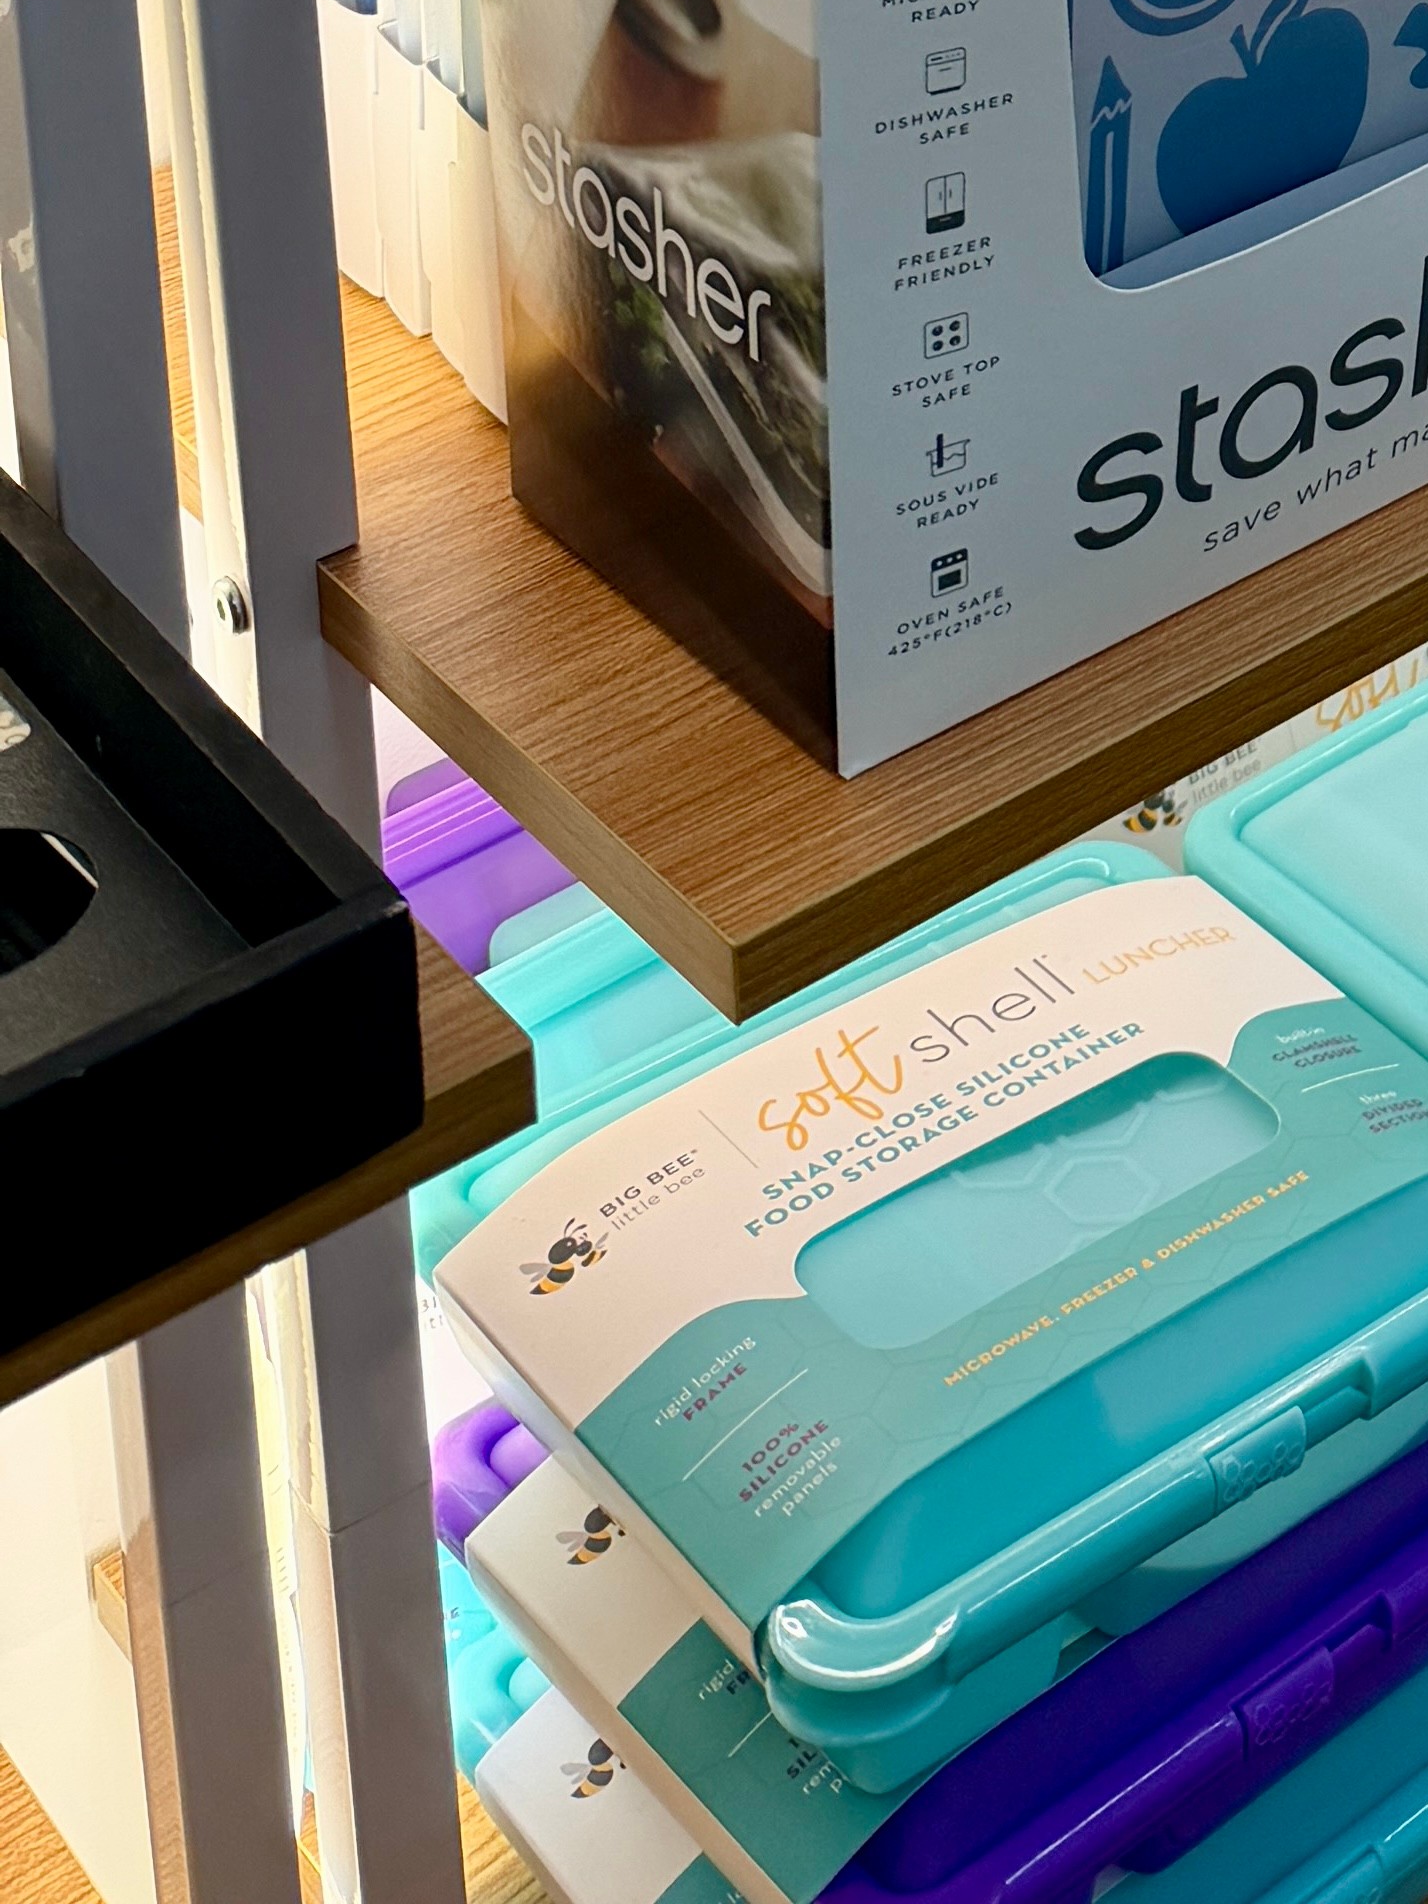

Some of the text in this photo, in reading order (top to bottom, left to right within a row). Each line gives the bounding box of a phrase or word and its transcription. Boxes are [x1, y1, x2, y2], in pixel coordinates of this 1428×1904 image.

[874, 92, 1015, 135] DISHWASHER
[521, 121, 771, 362] stasher
[891, 355, 1002, 398] STOVE TOP
[757, 923, 1240, 1153] soft shell LUNCHER
[1058, 1264, 1141, 1320] FREEZER
[1139, 1256, 1157, 1273] &
[1155, 1192, 1268, 1262] DISHWASHER
[1263, 1170, 1311, 1206] SAFE
[651, 1333, 759, 1429] rigid locking
[735, 1417, 831, 1507] SILICONE
[750, 1434, 844, 1522] removable
